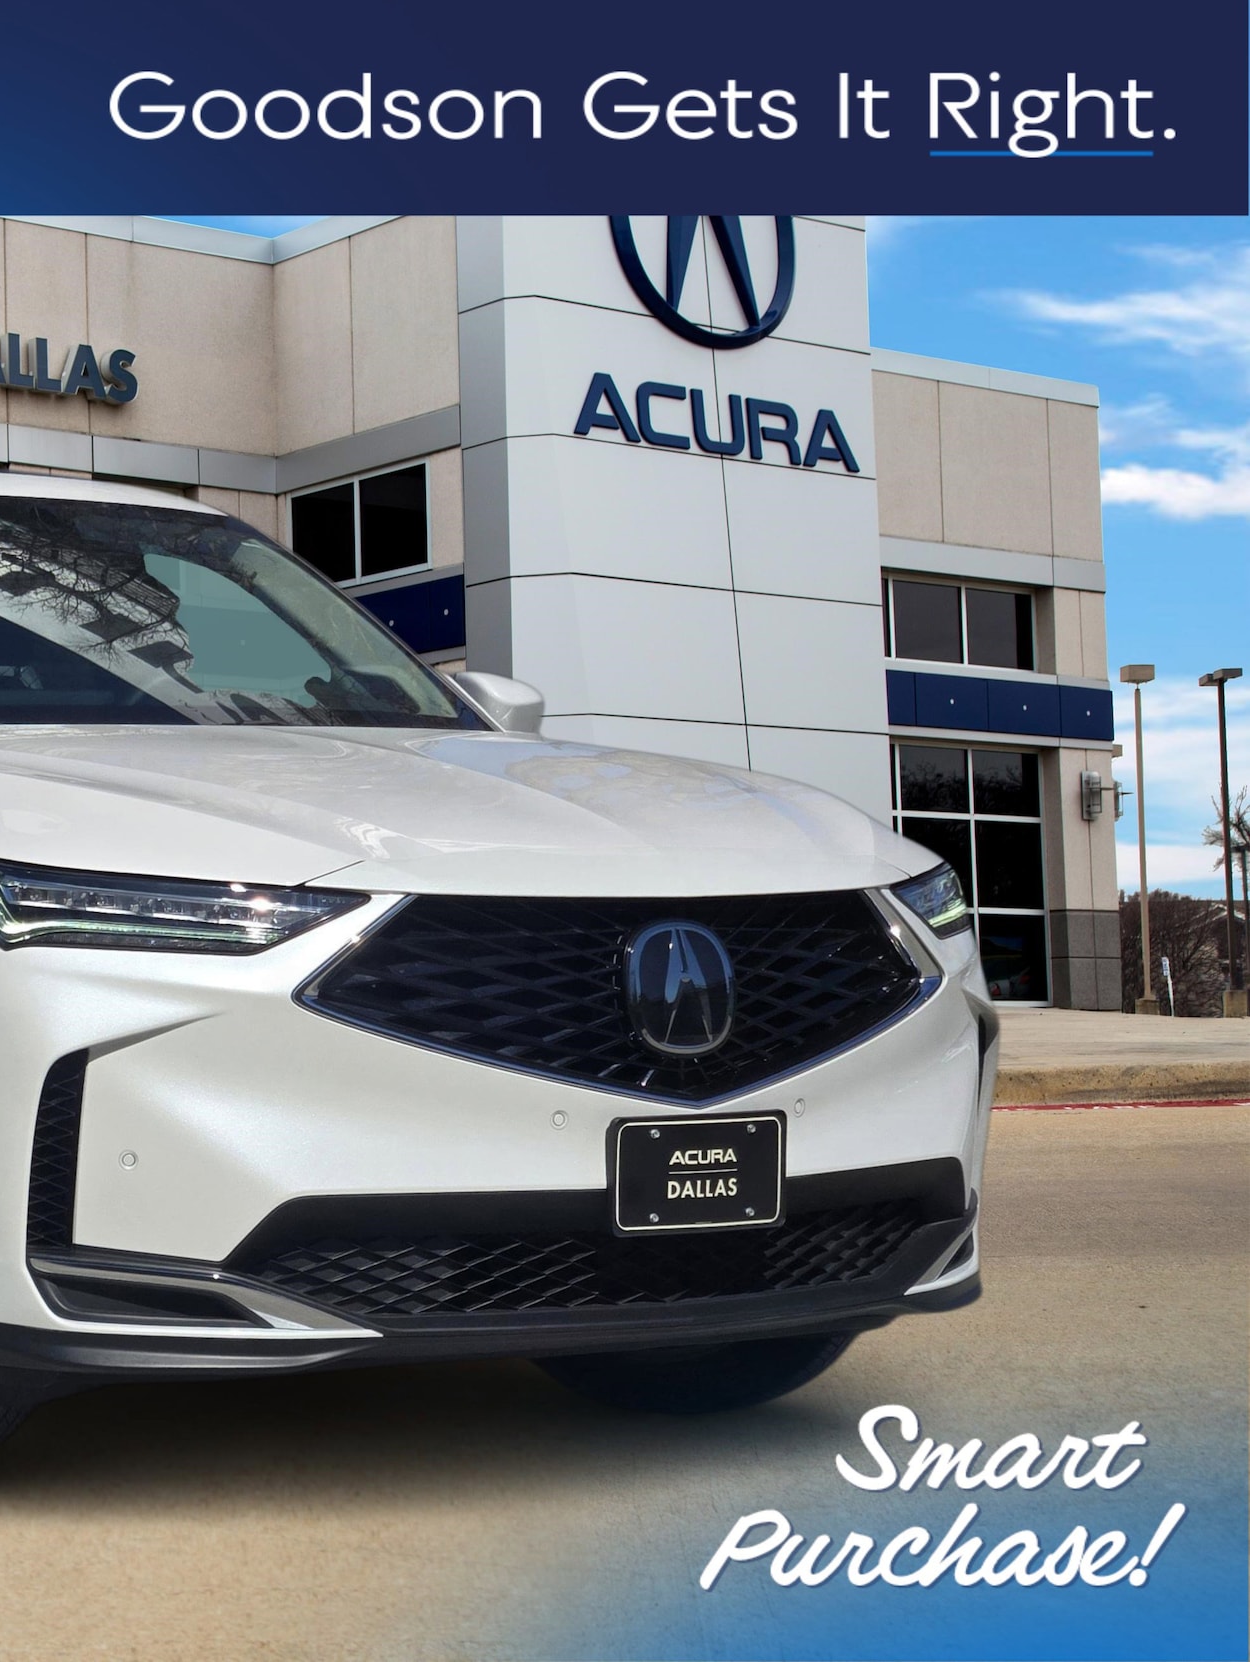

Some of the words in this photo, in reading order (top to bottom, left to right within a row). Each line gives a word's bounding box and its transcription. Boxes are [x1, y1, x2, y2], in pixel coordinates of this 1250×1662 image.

[573, 372, 860, 473] ACURA
[669, 1148, 738, 1166] ACURA
[667, 1177, 738, 1199] DALLAS
